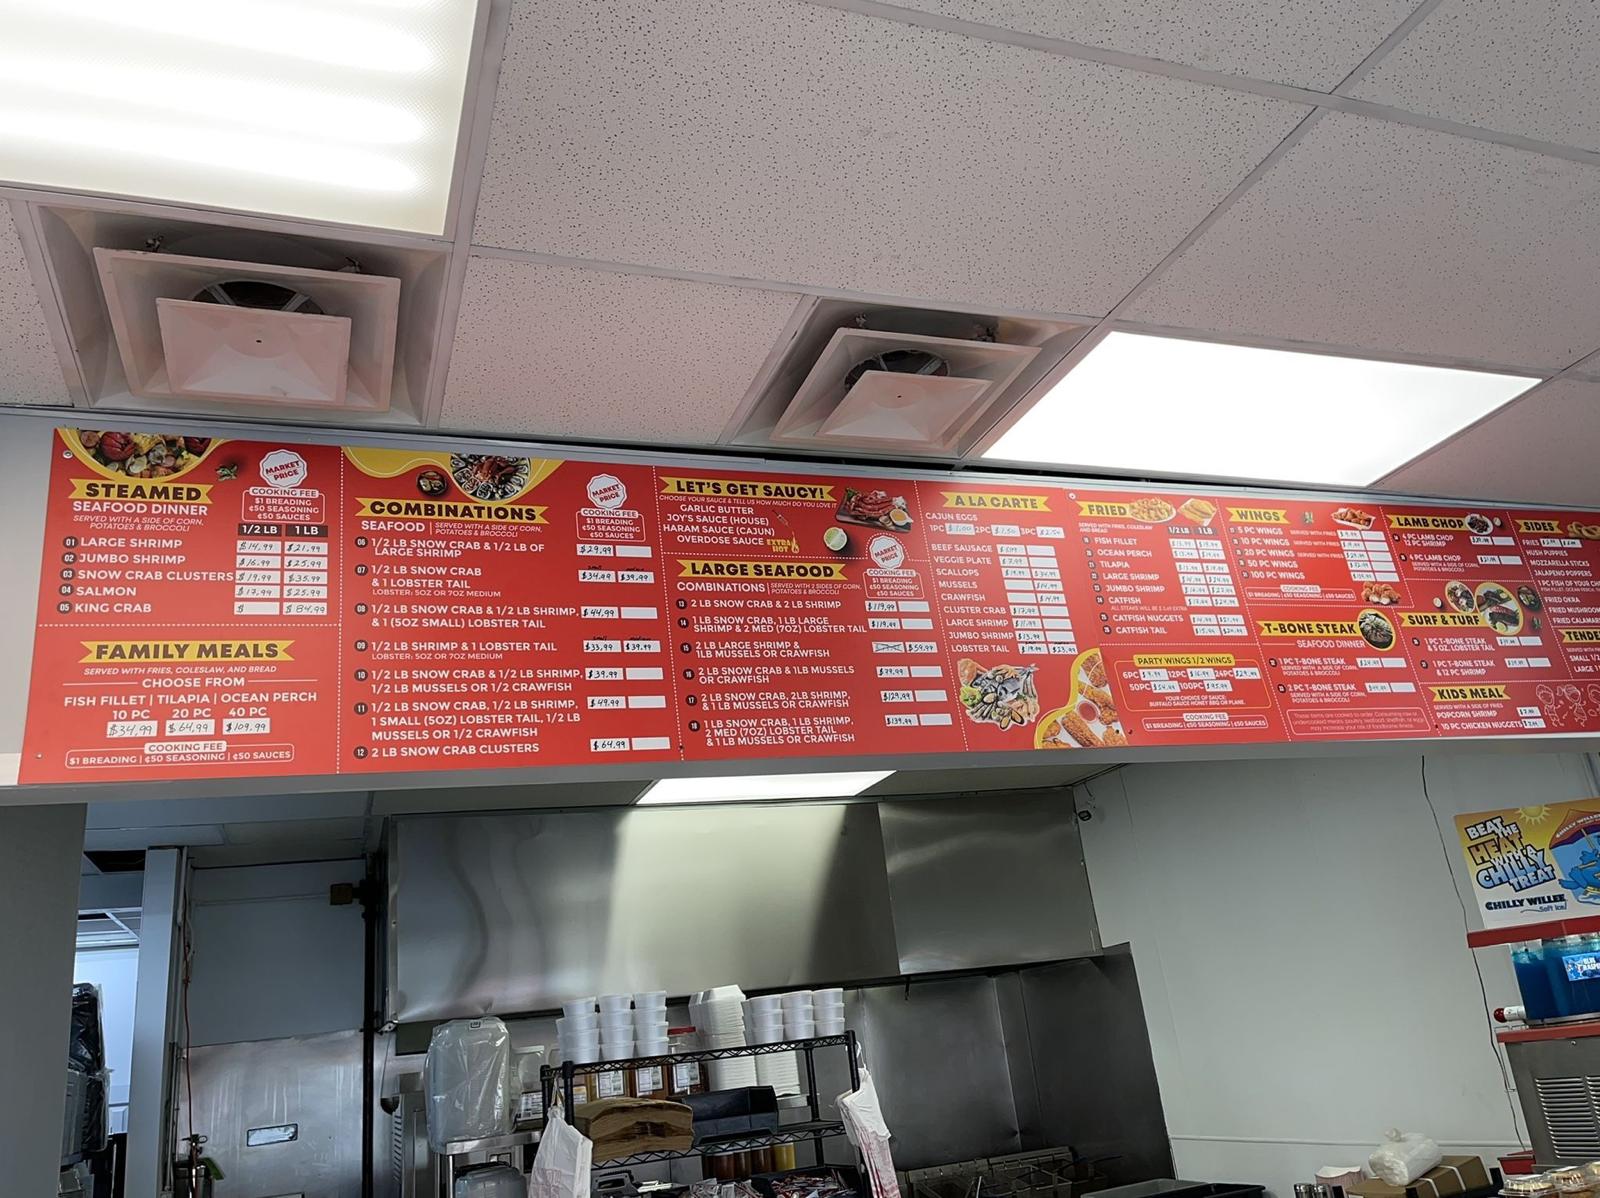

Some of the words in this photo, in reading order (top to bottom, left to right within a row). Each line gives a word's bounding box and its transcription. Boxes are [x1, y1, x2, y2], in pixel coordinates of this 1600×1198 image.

[265, 460, 300, 474] MARKET
[273, 469, 300, 481] PRICE
[86, 483, 202, 501] STEAMED
[252, 488, 297, 497] COOKING
[300, 489, 317, 497] FEE
[592, 484, 620, 496] MARKET
[676, 480, 723, 494] LET'S
[726, 482, 760, 496] GET
[763, 485, 825, 499] SAUCY!
[599, 492, 620, 503] PRICE
[955, 496, 965, 506] A
[968, 496, 986, 507] LA
[990, 497, 1038, 509] CARTE
[73, 501, 147, 514] SEAFOOD
[151, 503, 208, 515] DINNER
[370, 501, 536, 521] COMBINATIONS
[680, 504, 716, 513] GARLIC
[718, 506, 754, 514] BUTTER
[1088, 504, 1127, 515] FRIED
[667, 514, 694, 523] JOY'S
[696, 515, 727, 524] SAUCE
[730, 516, 769, 526] (HOUSE)
[1236, 510, 1281, 521] WINGS
[361, 521, 425, 532] SEAFOOD
[1397, 517, 1430, 527] LAMB
[1432, 518, 1464, 529] CHOP
[1524, 521, 1554, 532] SIDES
[242, 525, 261, 535] 1/2
[263, 526, 278, 535] LB
[295, 526, 300, 535] 1
[303, 526, 319, 535] LB
[663, 525, 700, 534] HARAM
[702, 526, 734, 535] SAUCE
[736, 526, 775, 536] (CAJUN)
[65, 538, 75, 546] 01
[80, 537, 126, 548] LARGE
[130, 539, 182, 548] SHRIMP
[677, 535, 730, 545] OVERDOSE
[733, 537, 764, 546] SAUCE
[239, 542, 273, 551] $14.99
[287, 543, 320, 552] $21.99
[579, 545, 611, 554] $29.99
[954, 545, 993, 553] SAUSAGE
[64, 554, 74, 562] 02
[78, 554, 129, 564] JUMBO
[133, 555, 186, 565] SHRIMP
[239, 558, 270, 566] $16.99
[287, 559, 321, 567] $25.99
[1099, 561, 1129, 569] TILAPIA
[371, 564, 390, 574] 1/2
[393, 565, 407, 575] LB
[410, 566, 447, 575] SNOW
[449, 566, 482, 576] CRAB
[691, 563, 748, 576] LARGE
[753, 565, 834, 577] SEAFOOD
[936, 569, 979, 577] SCALLOPS
[63, 570, 73, 578] 03
[78, 570, 122, 580] SNOW
[125, 571, 162, 581] CRAB
[167, 571, 233, 582] CLUSTERS
[239, 573, 271, 581] $19.99
[288, 574, 320, 582] $35.99
[621, 573, 649, 581] $39.99
[371, 579, 379, 587] &
[383, 579, 387, 588] 1
[391, 579, 442, 588] LOBSTER
[446, 580, 470, 589] TAIL
[677, 582, 765, 592] COMBINATIONS
[939, 581, 978, 589] MUSSELS
[61, 586, 71, 594] 04
[76, 586, 137, 597] SALMON
[237, 587, 272, 596] $17.99
[287, 587, 320, 596] $25.99
[941, 593, 986, 601] CRAWFISH
[60, 603, 70, 612] 05
[75, 603, 110, 613] KING
[114, 603, 152, 613] CRAB
[286, 604, 325, 614] $84.99
[691, 600, 697, 608] 2
[699, 600, 711, 608] LB
[713, 600, 744, 608] SNOW
[747, 600, 774, 608] CRAB
[583, 609, 615, 617] $44.99
[1113, 614, 1146, 622] CATFISH
[1148, 614, 1184, 622] NUGGETS
[1408, 614, 1439, 625] SURF
[1442, 615, 1449, 625] &
[1451, 614, 1480, 625] TURF
[1264, 623, 1315, 633] T-BONE
[1318, 623, 1357, 634] STEAK
[950, 645, 989, 653] LOBSTER
[991, 645, 1010, 653] TAIL
[1297, 640, 1335, 648] SEAFOOD
[1336, 640, 1366, 648] DINNER
[96, 644, 189, 660] FAMILY
[196, 643, 279, 659] MEALS
[142, 678, 201, 688] CHOOSE
[205, 677, 245, 687] FROM
[1437, 689, 1467, 699] KIDS
[1470, 688, 1503, 699] MEAL
[64, 696, 96, 707] FISH
[100, 695, 146, 706] FILLET
[157, 694, 210, 704] TILAPIA
[221, 693, 269, 703] OCEAN
[273, 692, 317, 702] PERCH
[590, 699, 620, 707] $49.99
[108, 724, 153, 737] $34.99
[168, 723, 208, 734] $64.99
[226, 722, 266, 733] $109.99
[371, 748, 379, 757] 2
[381, 748, 396, 757] LB
[399, 747, 439, 757] SNOW
[443, 746, 476, 755] CRAB
[480, 744, 540, 755] CLUSTERS
[593, 741, 625, 750] $64.99
[1465, 816, 1504, 840] BEAT
[1496, 822, 1521, 839] THE
[1468, 833, 1525, 866] HEAT
[1476, 849, 1547, 889] CHILLY
[1510, 865, 1556, 892] TREAT
[1485, 899, 1524, 910] CHILLY
